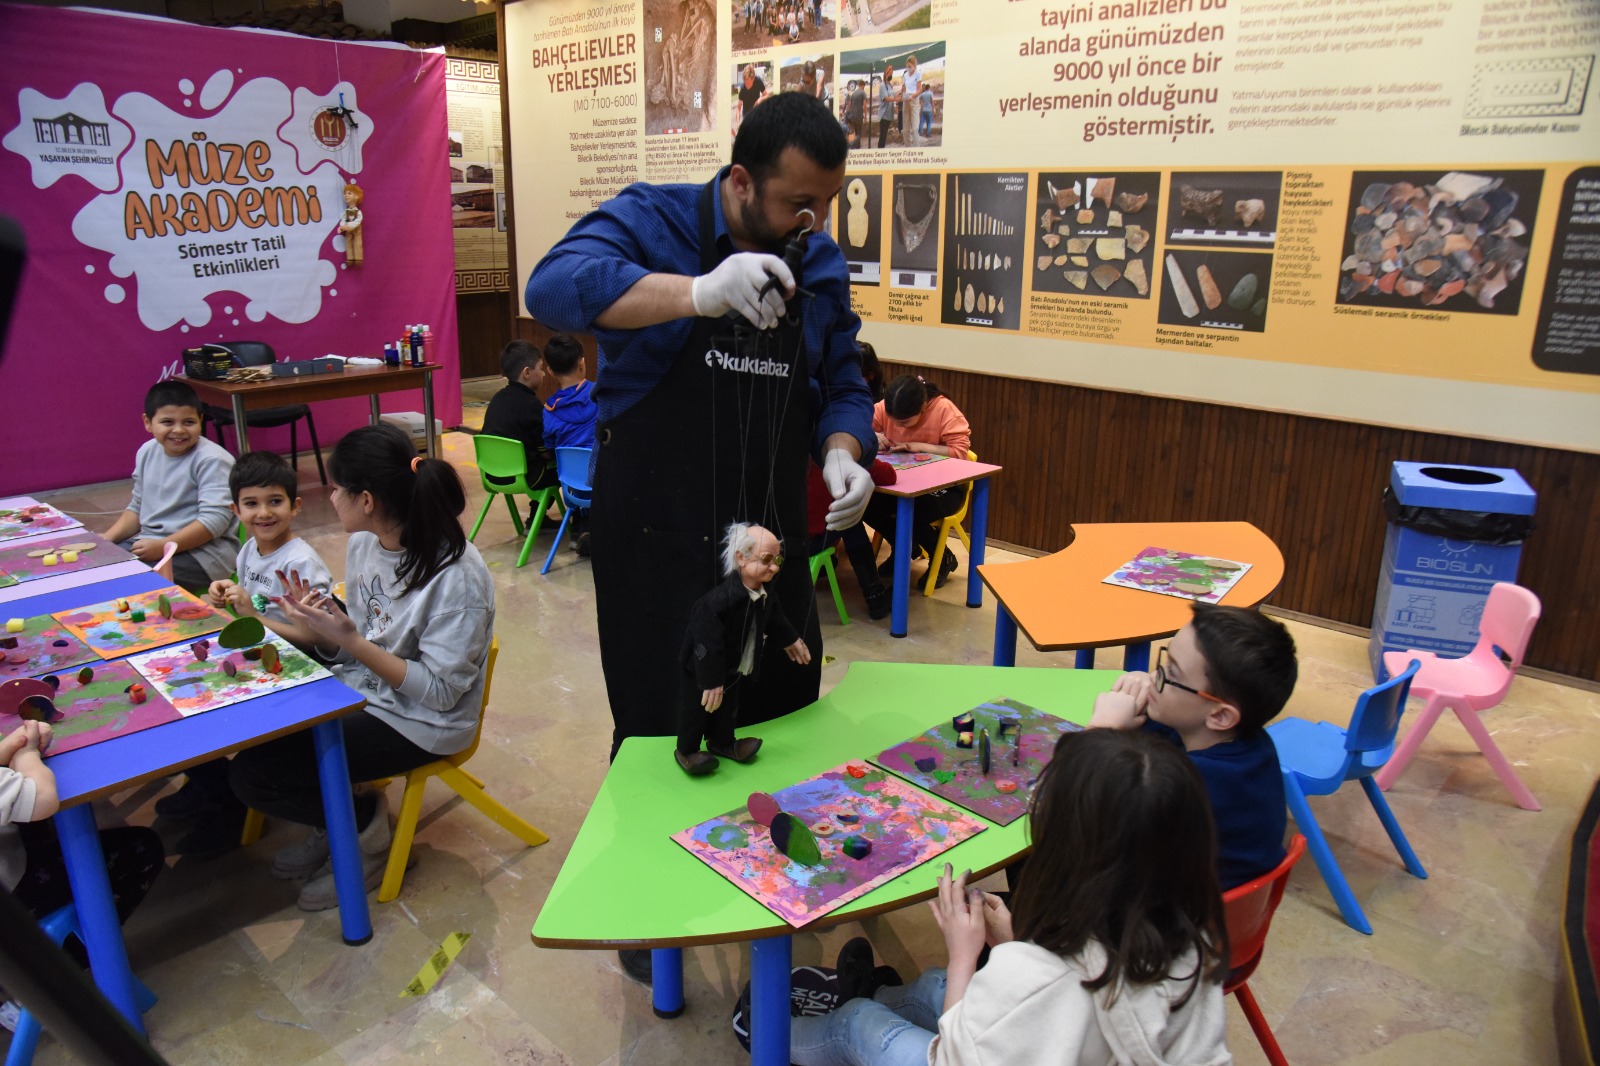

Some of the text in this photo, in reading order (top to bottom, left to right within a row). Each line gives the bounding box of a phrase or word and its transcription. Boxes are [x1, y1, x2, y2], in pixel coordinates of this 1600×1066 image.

[587, 7, 603, 19] 9000
[1041, 2, 1093, 30] tayini
[1098, 0, 1192, 21] analizleri
[1019, 22, 1224, 57] alanda günümüzden
[1054, 52, 1222, 84] 9000 yıl önce bir
[591, 92, 637, 110] 7100-6000)
[999, 84, 1218, 118] yerleşmenin olduğunu
[619, 116, 637, 125] sadece
[1083, 114, 1214, 143] göstermiştir.
[39, 154, 114, 165] YAŞAYAN ŞEHİR MÜZESİ
[596, 176, 609, 185] Müze
[178, 235, 286, 260] Sömestr Tatil
[193, 255, 280, 278] Etkinlikleri
[1030, 303, 1056, 311] örnekleri
[1087, 308, 1113, 316] bulundu.
[1156, 328, 1194, 338] Mermerden
[1206, 334, 1239, 342] serpantin
[1156, 337, 1213, 348] taşından baltalar.
[723, 352, 789, 377] kuklabaz
[1416, 557, 1494, 575] BIOSUN
